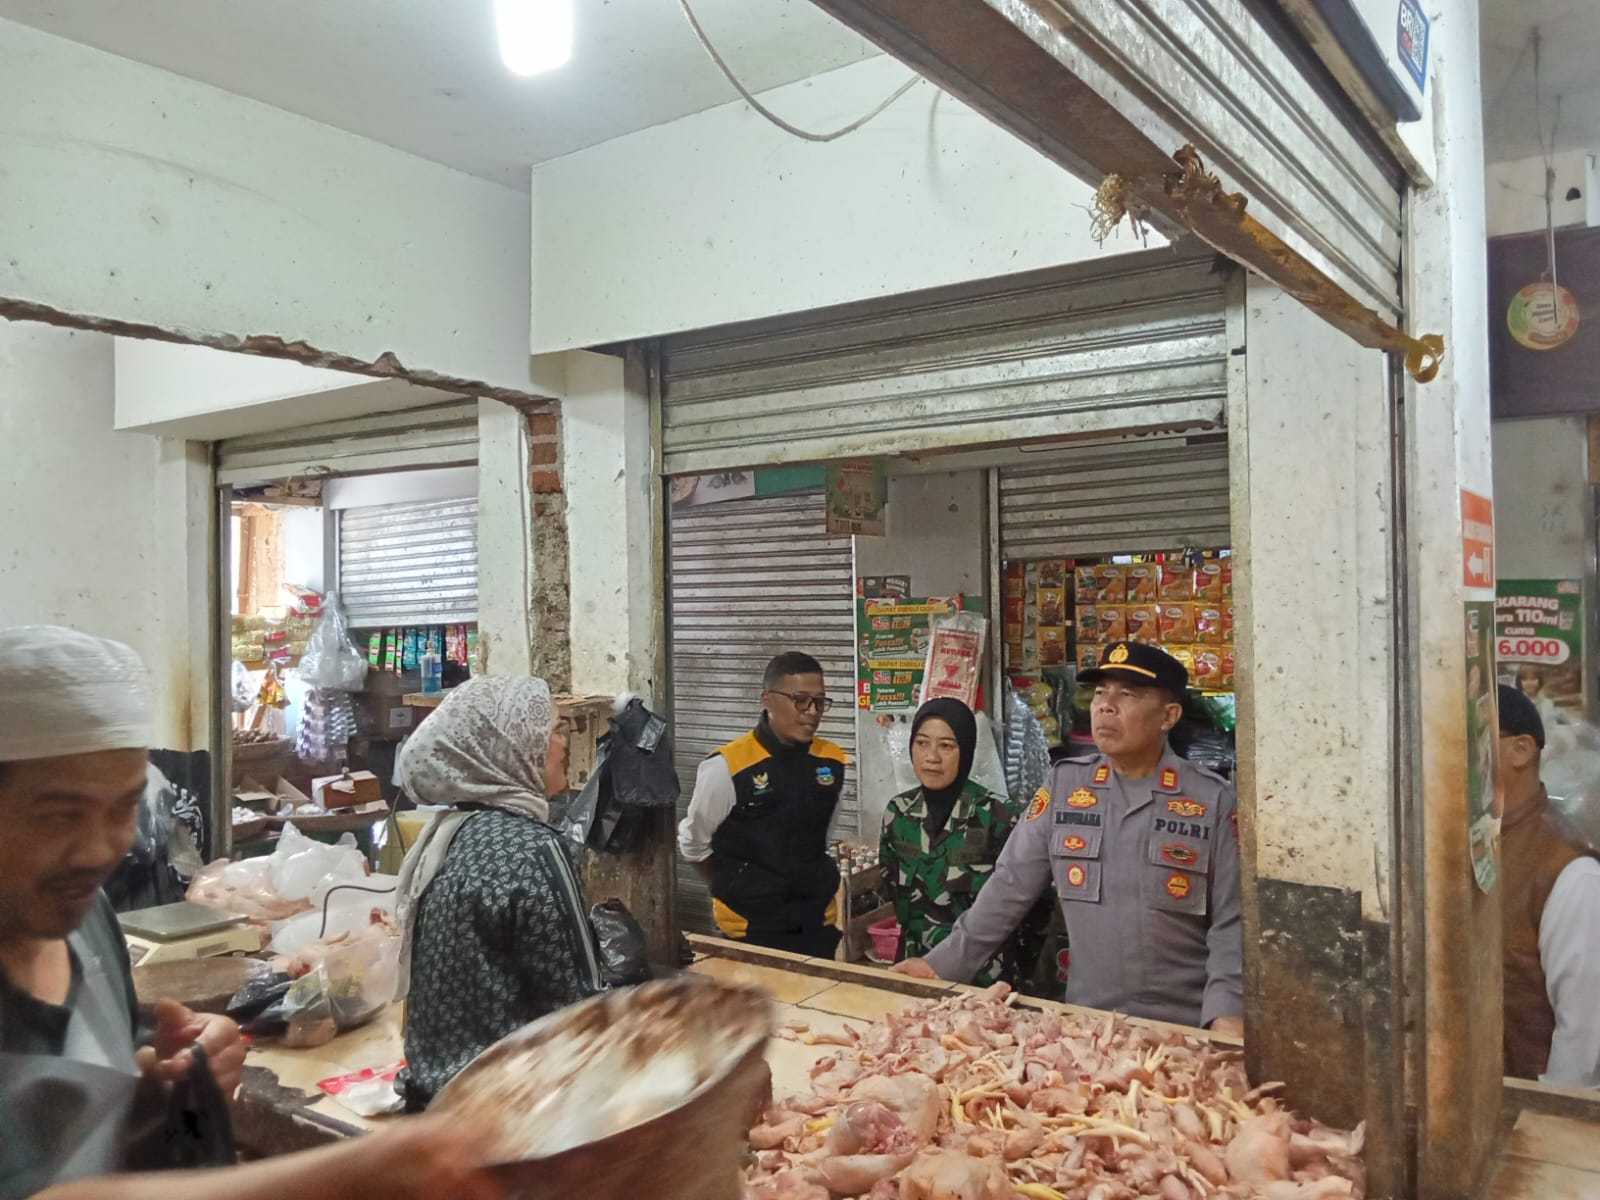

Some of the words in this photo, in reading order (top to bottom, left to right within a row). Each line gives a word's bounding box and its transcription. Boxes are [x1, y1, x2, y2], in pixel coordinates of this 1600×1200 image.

[1515, 609, 1558, 626] 110ml
[1498, 640, 1560, 657] 6.000
[1154, 818, 1210, 840] POLRI
